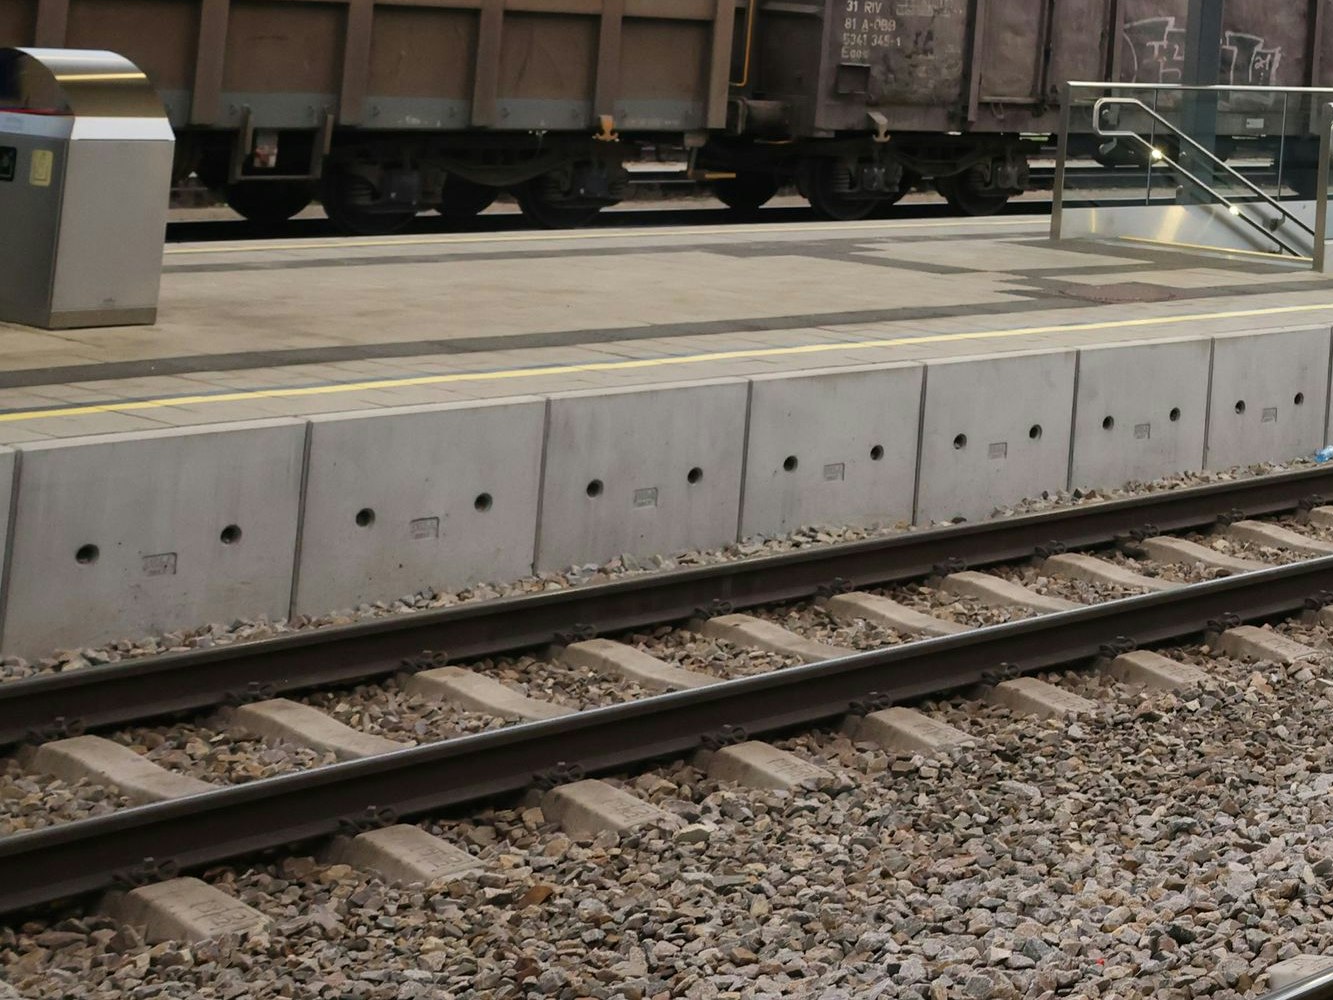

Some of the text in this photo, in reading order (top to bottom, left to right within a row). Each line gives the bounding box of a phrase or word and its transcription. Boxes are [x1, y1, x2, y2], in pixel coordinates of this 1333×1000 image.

[846, 0, 858, 12] 31
[864, 1, 882, 14] RIV
[844, 18, 856, 30] 81
